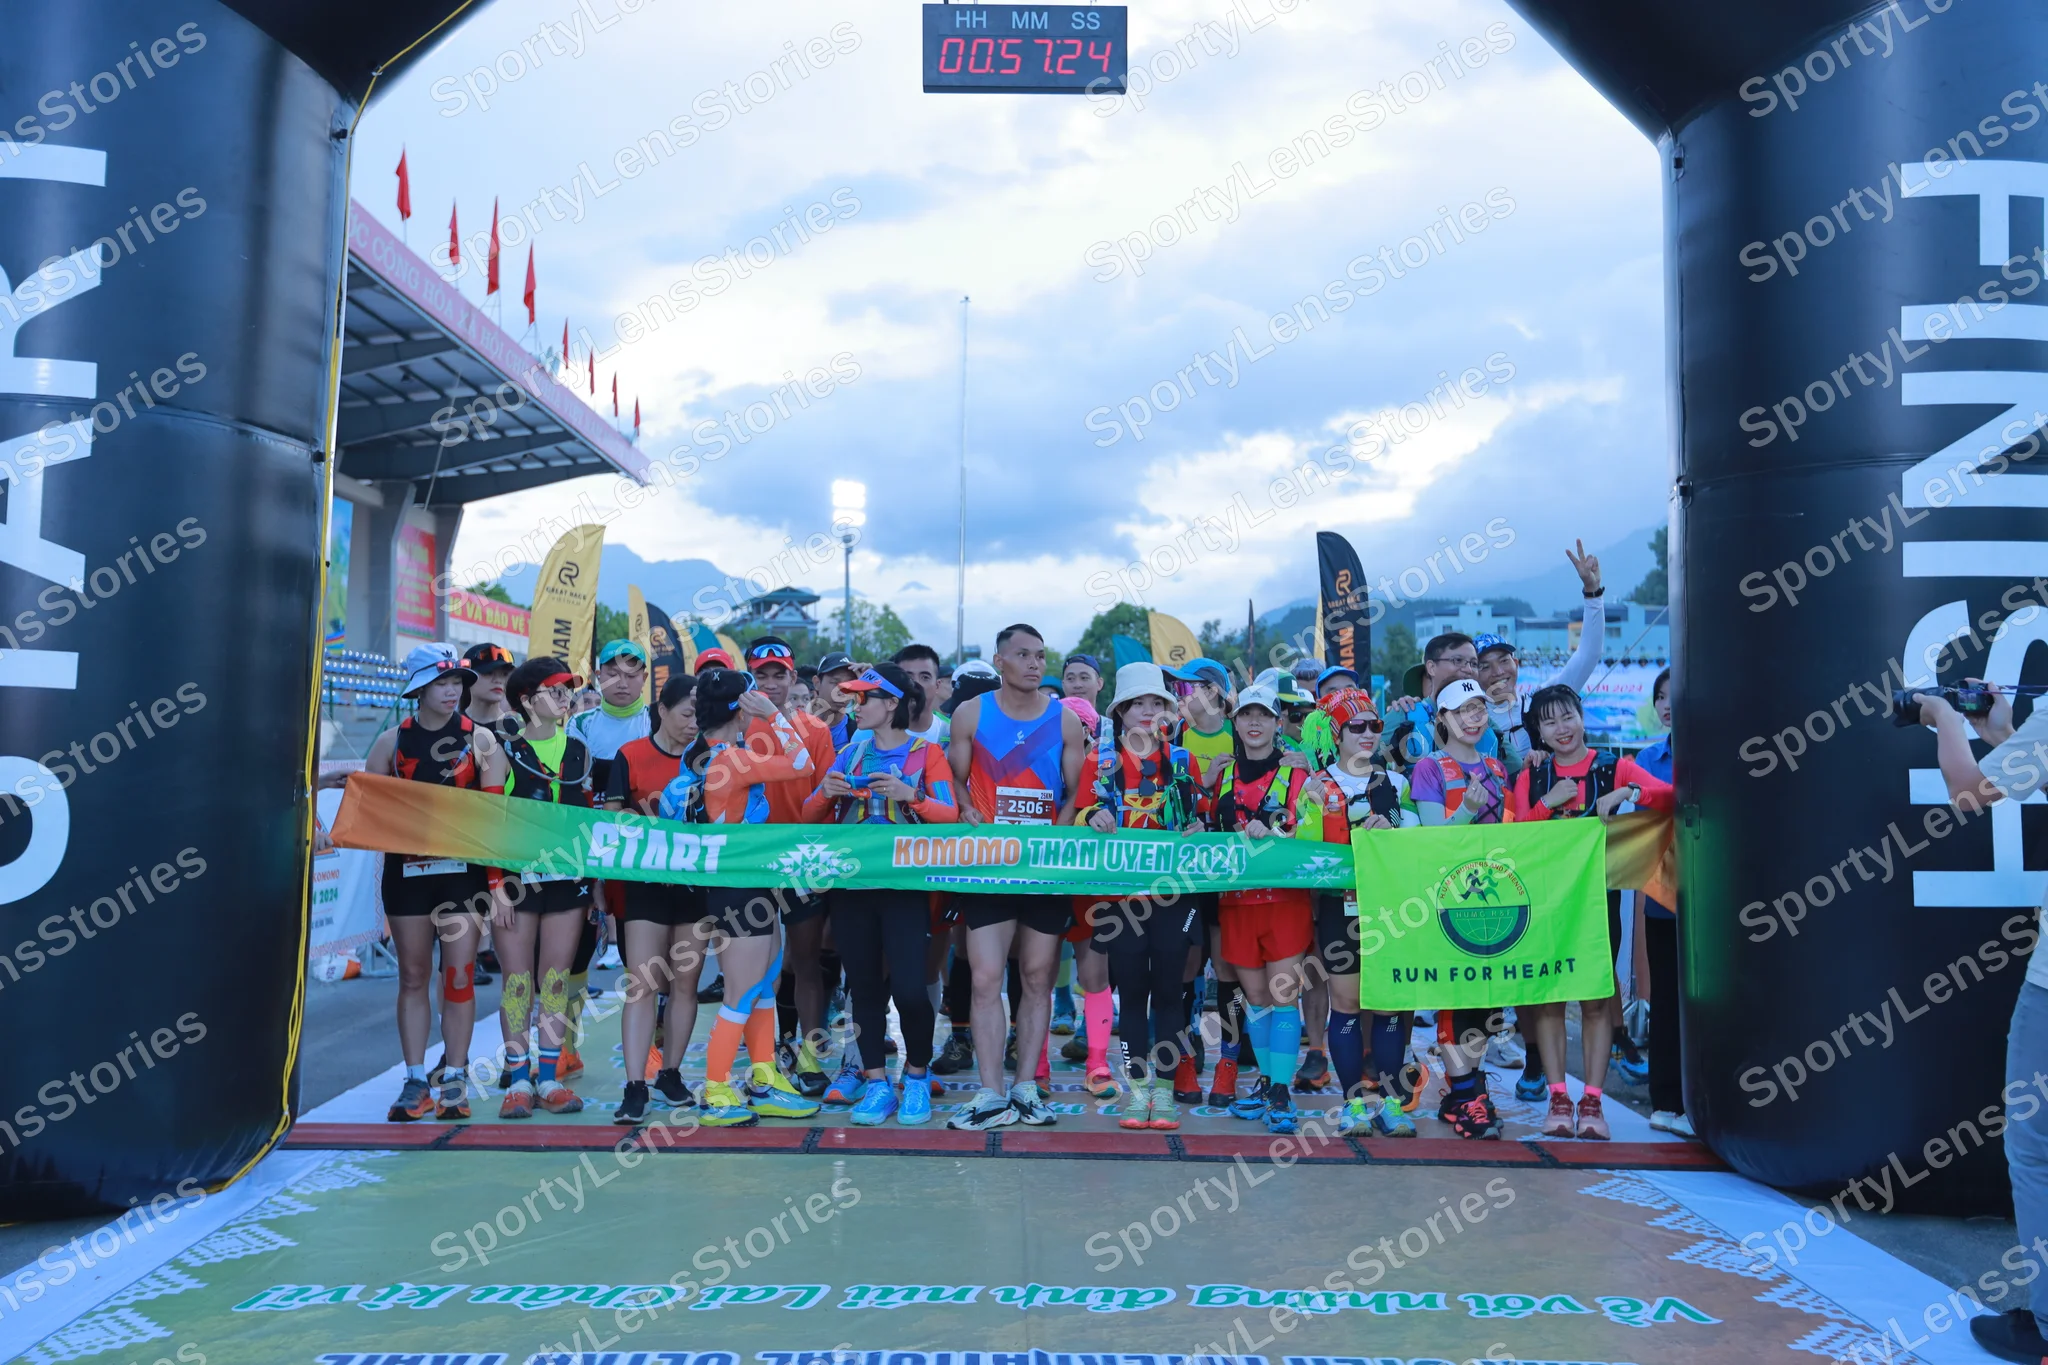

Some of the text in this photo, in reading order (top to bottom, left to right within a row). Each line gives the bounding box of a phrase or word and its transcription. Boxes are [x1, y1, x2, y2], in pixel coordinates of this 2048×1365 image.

[955, 11, 1101, 30] HH MM SS
[1008, 799, 1044, 815] 2506
[586, 821, 728, 875] START
[892, 836, 1247, 875] KOMOMO THAN UYEN 2024
[1393, 958, 1576, 983] RUN FOR HEART
[1120, 1041, 1132, 1070] RUN
